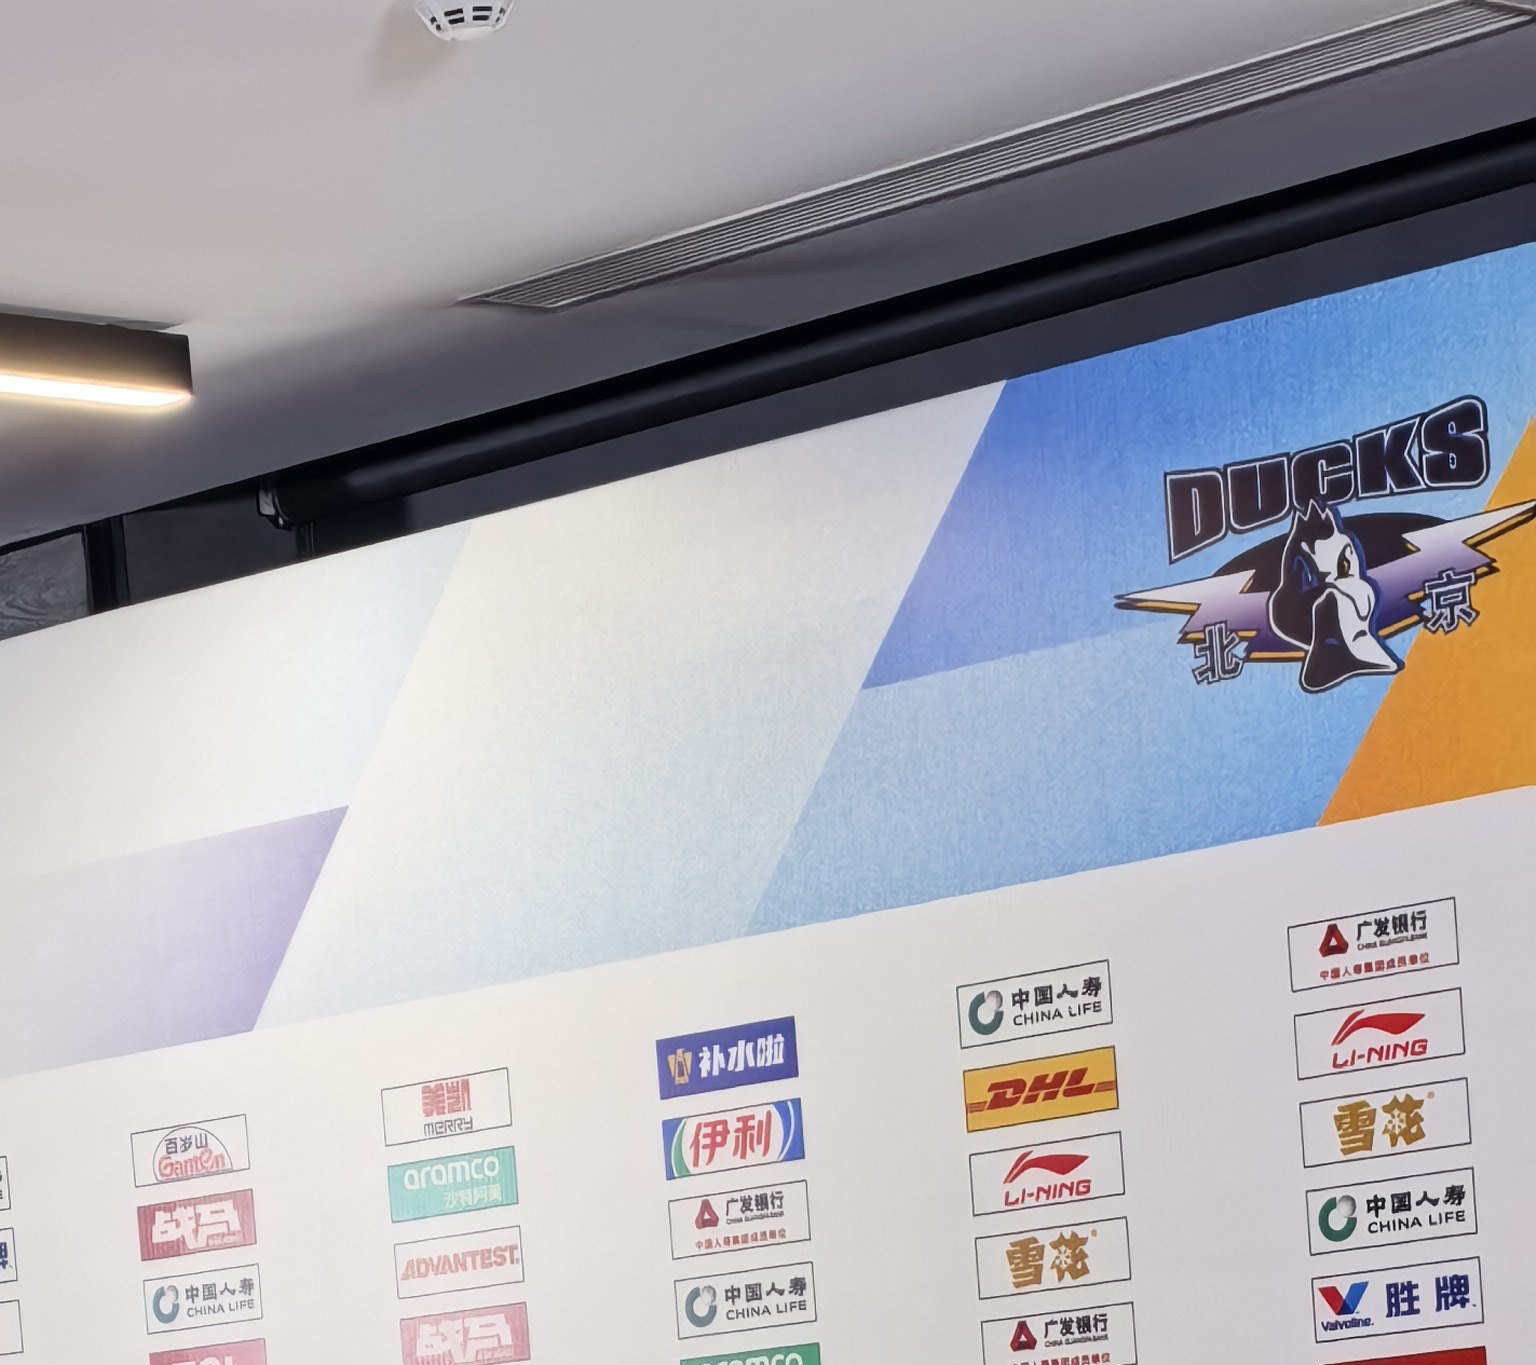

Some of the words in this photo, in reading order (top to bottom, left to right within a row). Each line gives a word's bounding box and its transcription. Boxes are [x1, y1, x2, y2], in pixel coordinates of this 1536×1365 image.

[1164, 395, 1491, 564] DUCKS
[1193, 621, 1247, 686] 北
[1421, 569, 1480, 634] 京
[1357, 909, 1427, 941] 广发银行
[1011, 976, 1102, 1010] 中国人寿
[1013, 1008, 1063, 1026] CHINA
[1068, 1001, 1102, 1017] LIFE
[699, 1033, 785, 1078] 补水啦
[1332, 1038, 1428, 1069] LI-NING
[986, 1067, 1096, 1110] DHL
[690, 1110, 773, 1168] 伊利
[1333, 1093, 1426, 1156] 雪花
[164, 1133, 208, 1154] 百岁山
[403, 1156, 499, 1190] aramco
[726, 1191, 785, 1218] 广发银行
[1004, 1179, 1091, 1207] LI-NING
[1366, 1184, 1466, 1218] 中国人寿
[1367, 1217, 1422, 1234] CHINA
[1429, 1210, 1466, 1226] LIFE
[400, 1244, 519, 1281] ADVANTEST
[1006, 1231, 1090, 1289] 雪花
[185, 1278, 254, 1303] 中国人寿
[724, 1277, 807, 1306] 中国人寿
[1385, 1274, 1471, 1318] 胜牌
[187, 1302, 224, 1318] CHINA
[228, 1299, 254, 1313] LIFE
[726, 1305, 772, 1321] CHINA
[776, 1300, 807, 1315] LIFE
[1044, 1314, 1108, 1338] 广发银行
